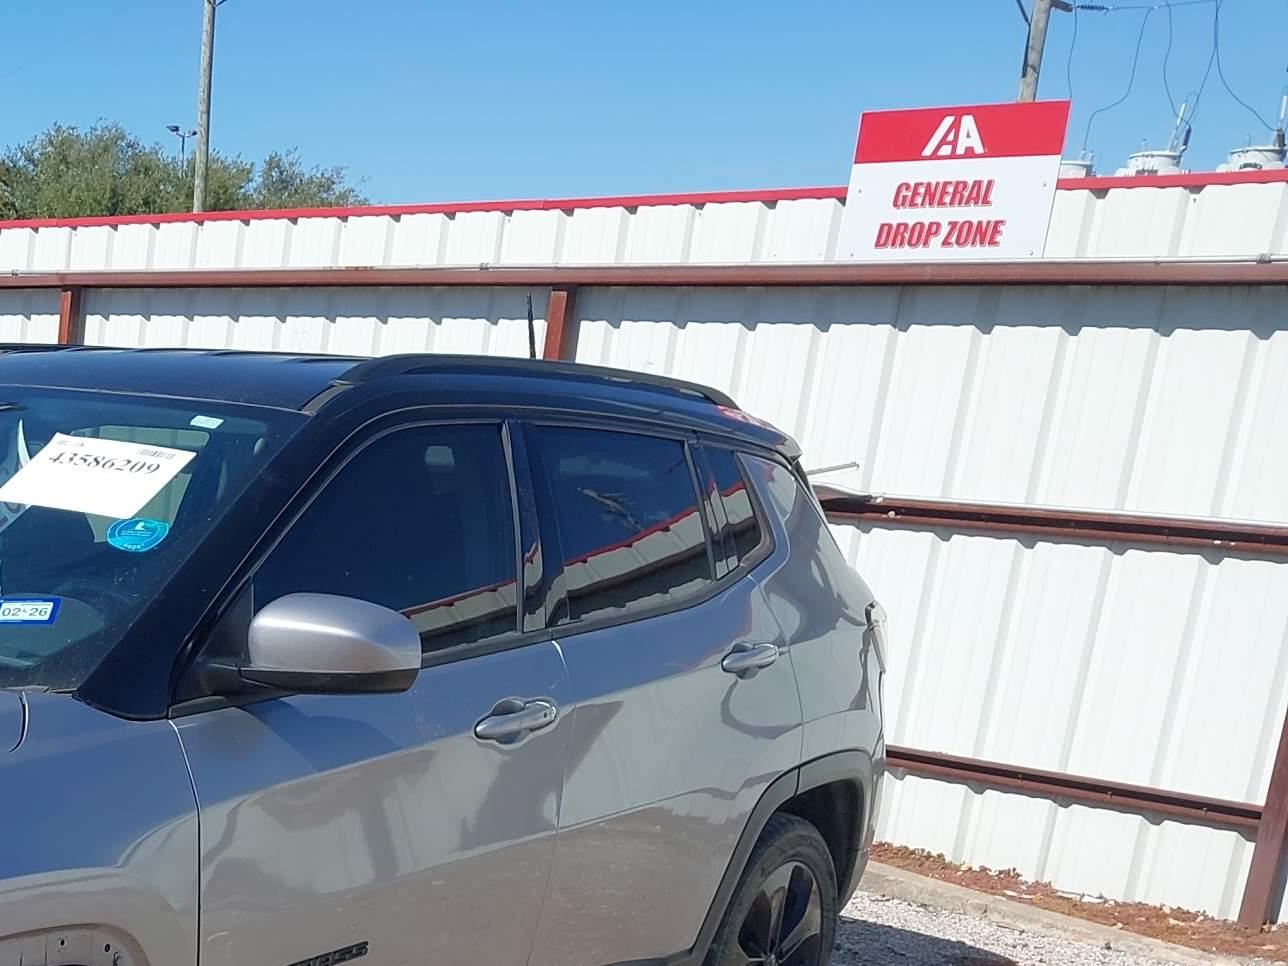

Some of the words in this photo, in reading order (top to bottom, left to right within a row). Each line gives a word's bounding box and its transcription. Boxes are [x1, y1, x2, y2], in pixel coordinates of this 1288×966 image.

[892, 179, 995, 209] GENERAL
[874, 221, 941, 249] DROP
[940, 219, 1005, 248] ZONE
[49, 451, 161, 475] 43586209
